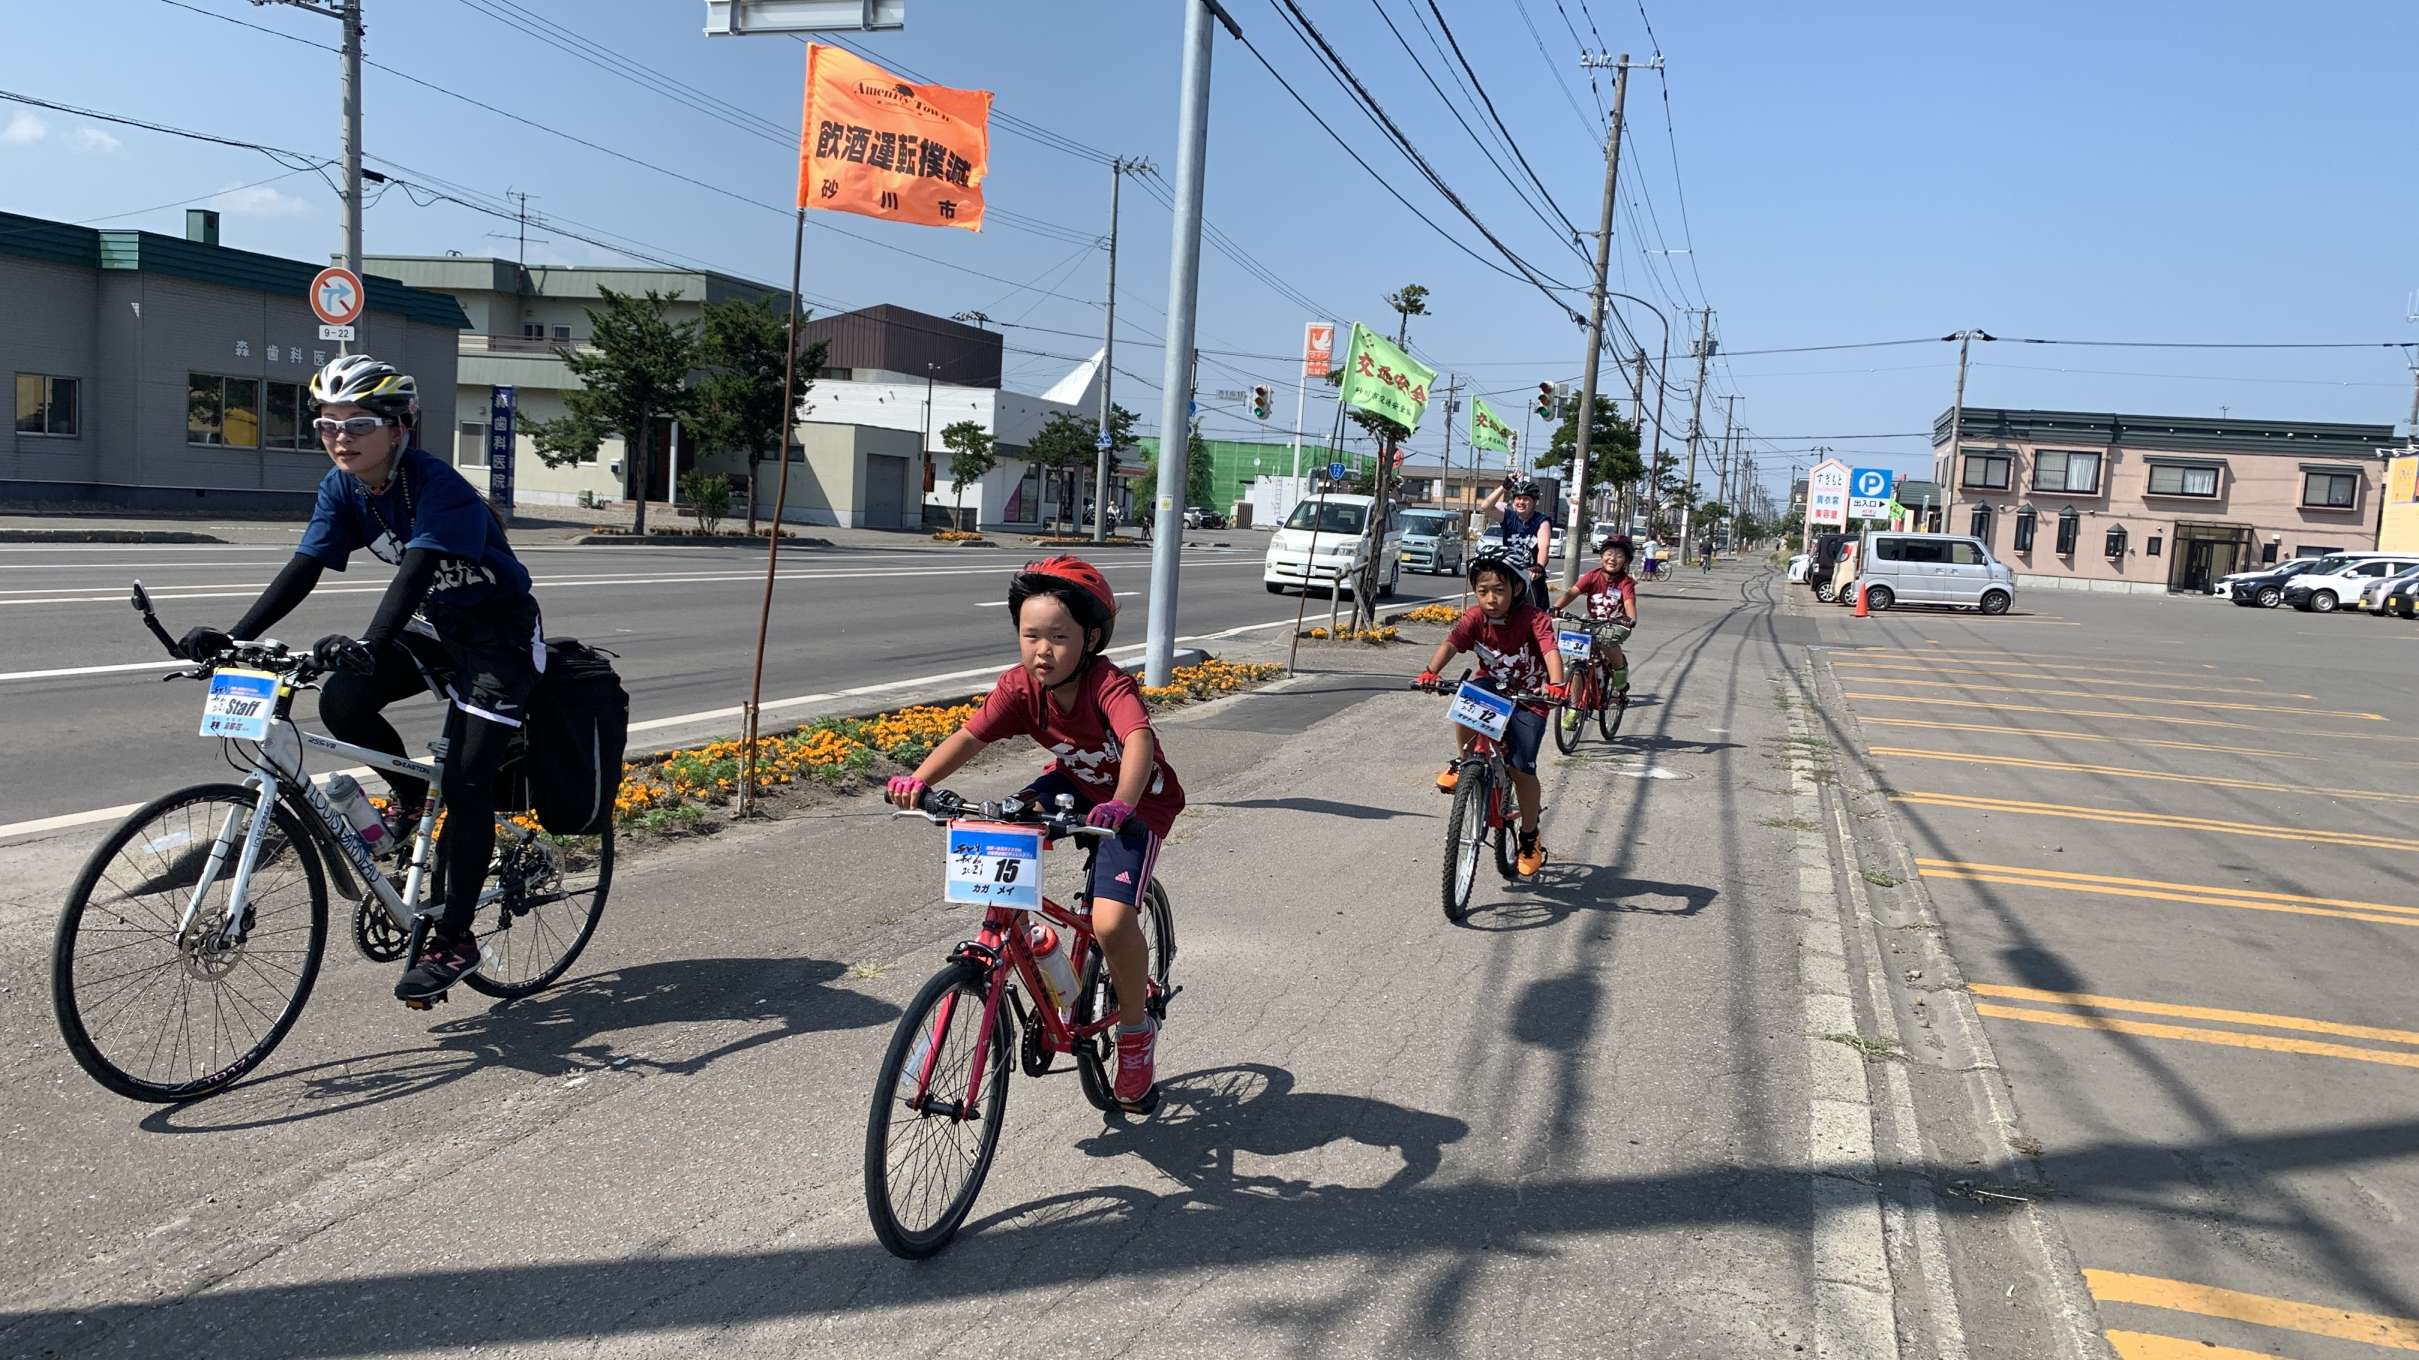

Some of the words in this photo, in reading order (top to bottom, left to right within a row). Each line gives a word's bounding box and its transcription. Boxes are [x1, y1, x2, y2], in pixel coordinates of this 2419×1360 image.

[815, 120, 972, 188] 飲酒運転撲滅
[821, 178, 958, 220] 砂川市
[324, 328, 349, 338] 9-22
[234, 340, 342, 366] 森歯科医
[1355, 351, 1428, 407] 交通安全
[1864, 475, 1881, 493] P
[1853, 500, 1877, 508] 出入口
[225, 698, 262, 717] Staff
[1478, 709, 1497, 723] 12
[309, 785, 340, 830] LOUIS
[994, 858, 1021, 884] 15
[972, 884, 990, 894] カガ
[997, 886, 1015, 896] メイ
